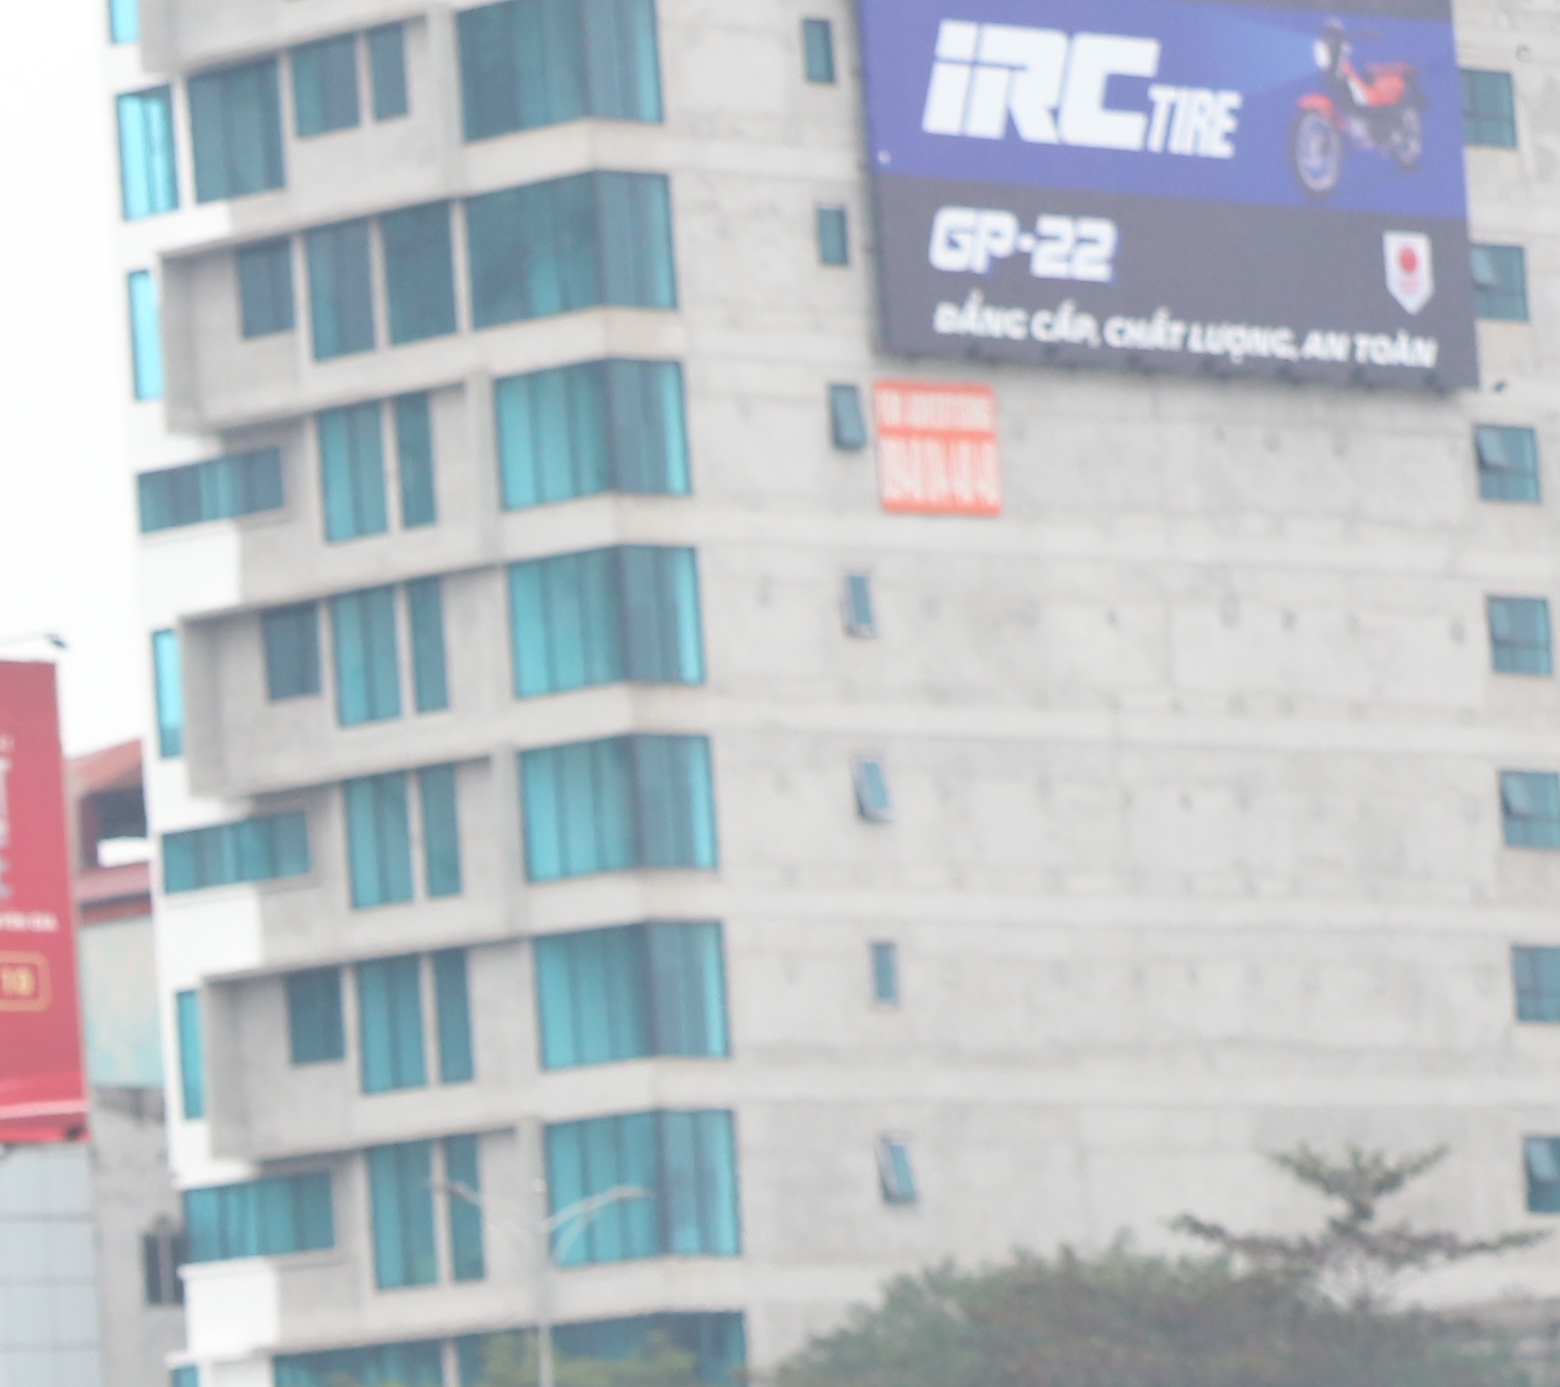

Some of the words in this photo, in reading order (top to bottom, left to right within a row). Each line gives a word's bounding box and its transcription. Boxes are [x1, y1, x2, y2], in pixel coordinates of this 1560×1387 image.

[1146, 83, 1243, 160] TIRE
[928, 205, 1118, 283] GP-22
[1103, 306, 1187, 353] CHẤT
[1301, 326, 1351, 362] AN
[1354, 327, 1439, 369] TOÀN
